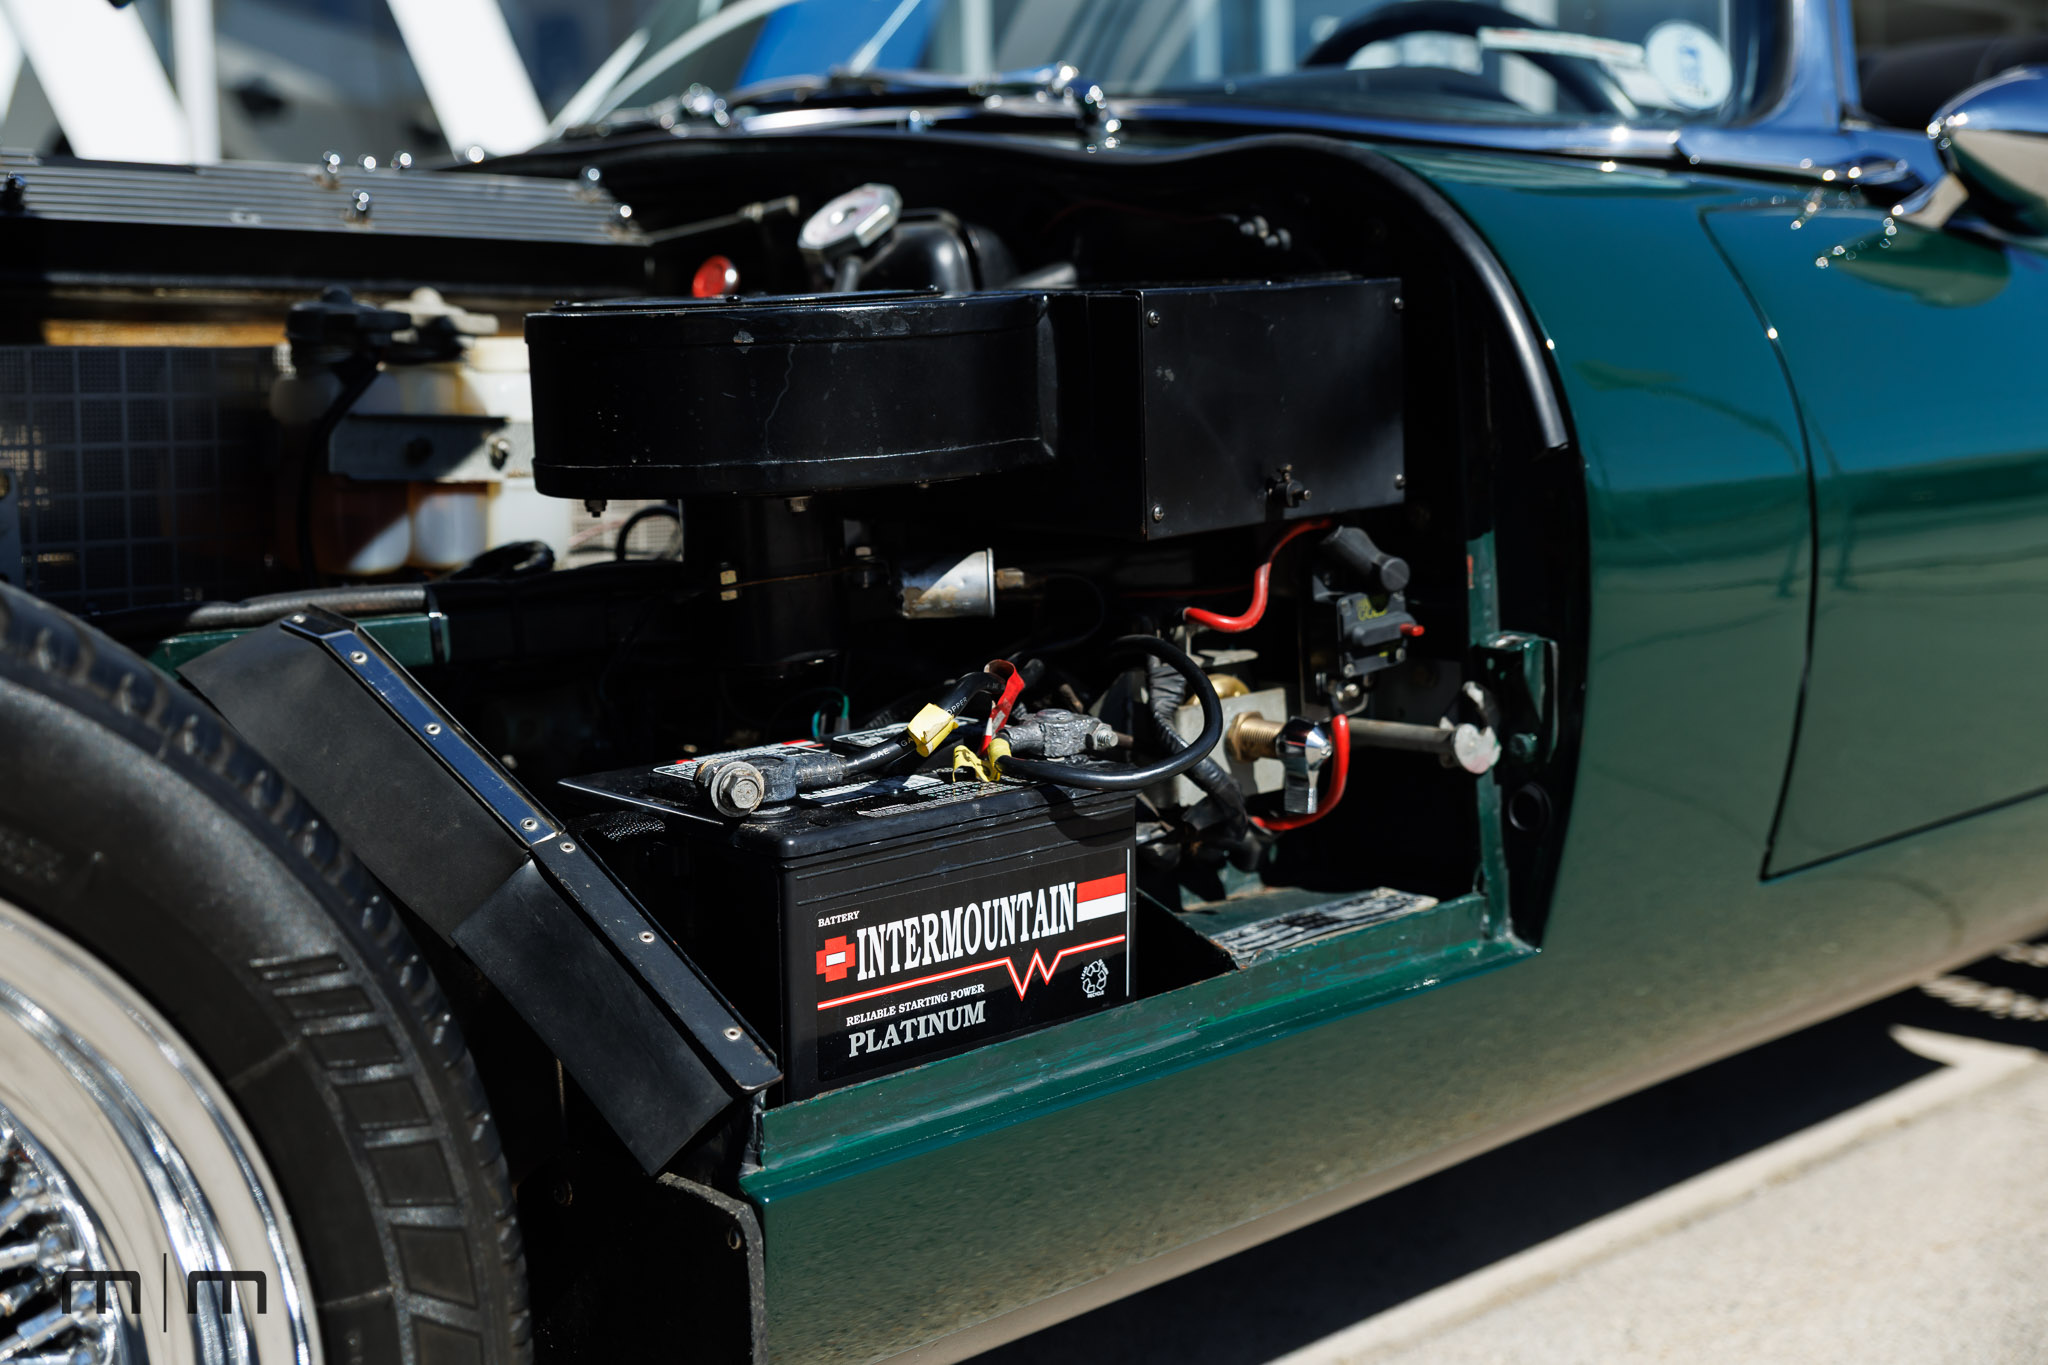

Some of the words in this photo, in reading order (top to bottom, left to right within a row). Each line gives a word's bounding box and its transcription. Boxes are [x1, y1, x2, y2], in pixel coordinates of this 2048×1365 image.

[870, 748, 889, 760] SAE
[946, 696, 968, 715] OPPER
[818, 910, 860, 927] BATTERY
[857, 881, 1076, 981] INTERMOUNTAIN
[846, 1006, 896, 1027] RELIABLE
[898, 993, 948, 1014] STARTING
[950, 984, 985, 1002] POWER
[848, 1001, 986, 1058] PLATINUM
